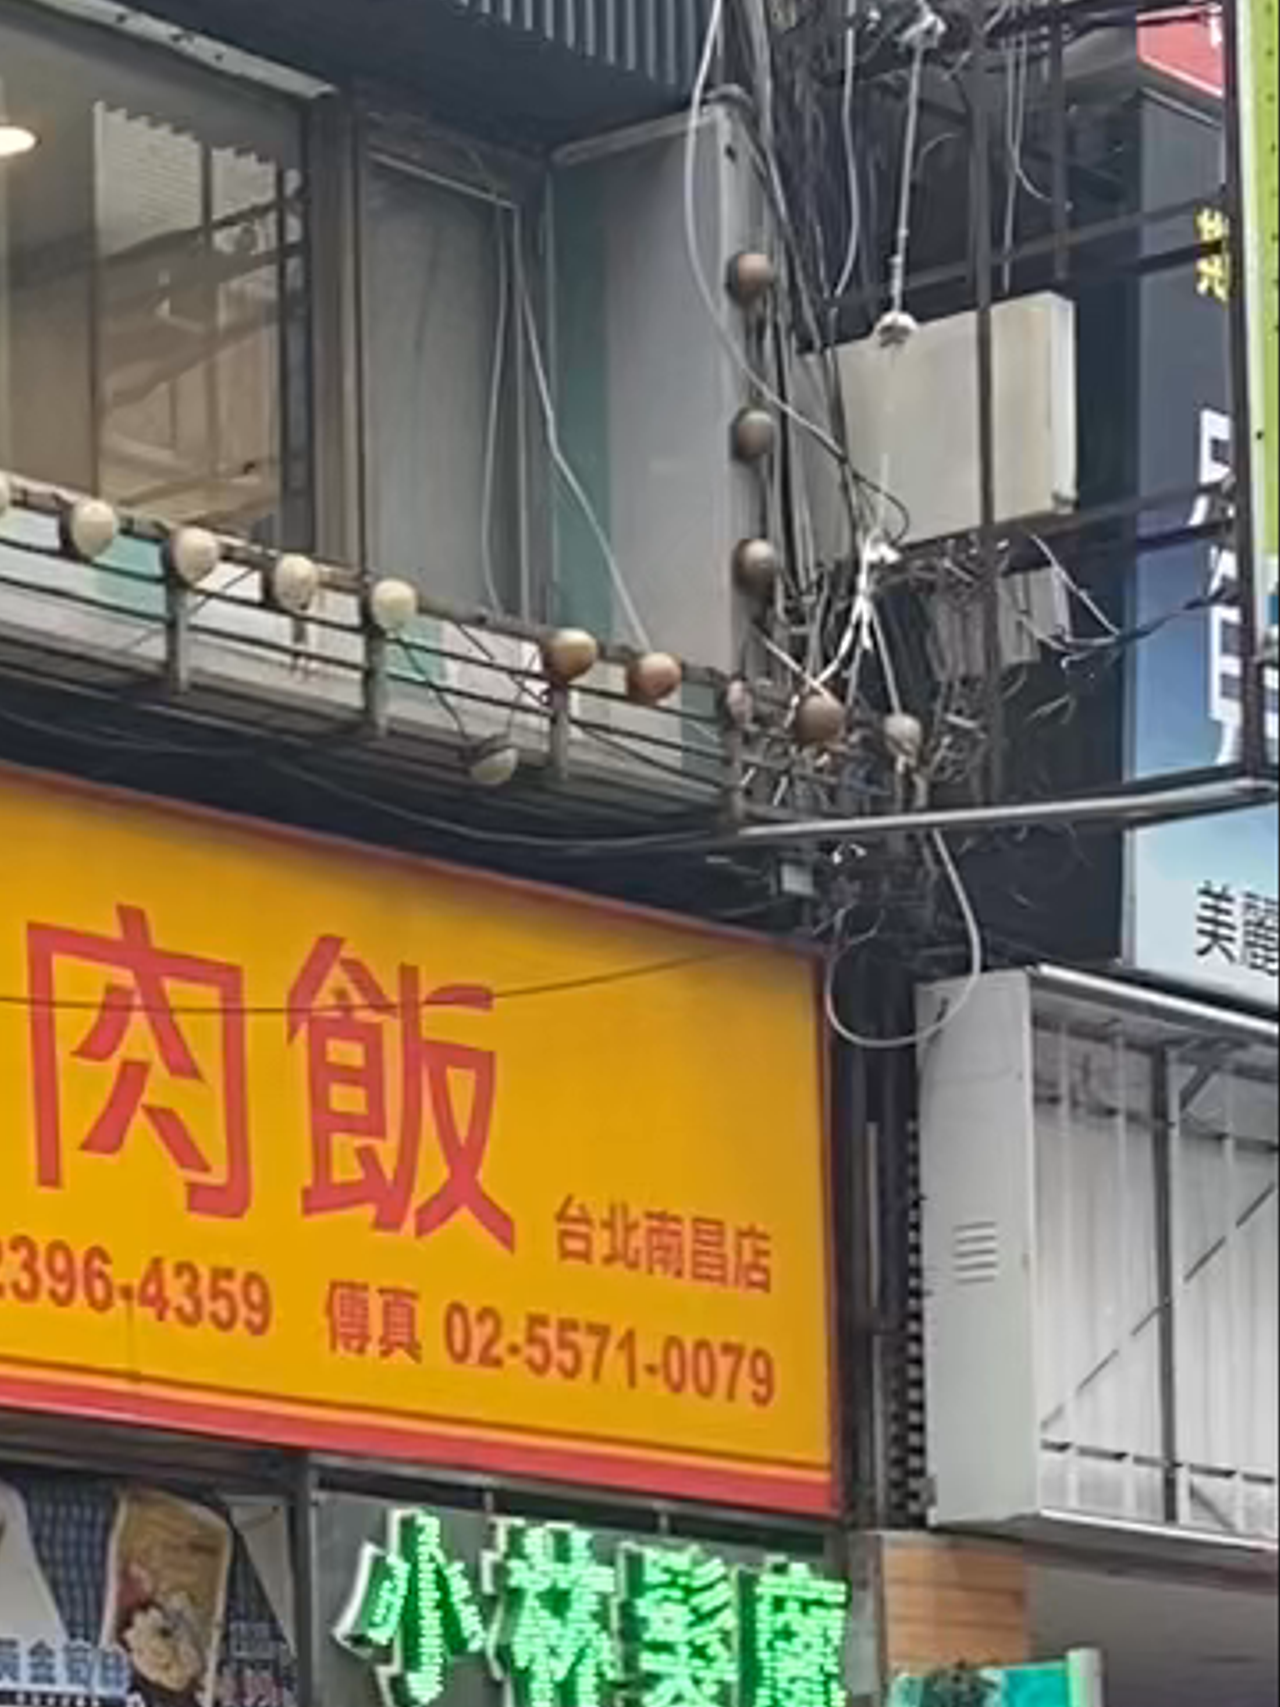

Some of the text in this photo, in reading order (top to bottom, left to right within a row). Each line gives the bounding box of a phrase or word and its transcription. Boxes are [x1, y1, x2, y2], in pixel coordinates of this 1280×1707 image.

[552, 1192, 775, 1294] 台北南昌店
[324, 1278, 777, 1409] 傳真 02-5571-0079
